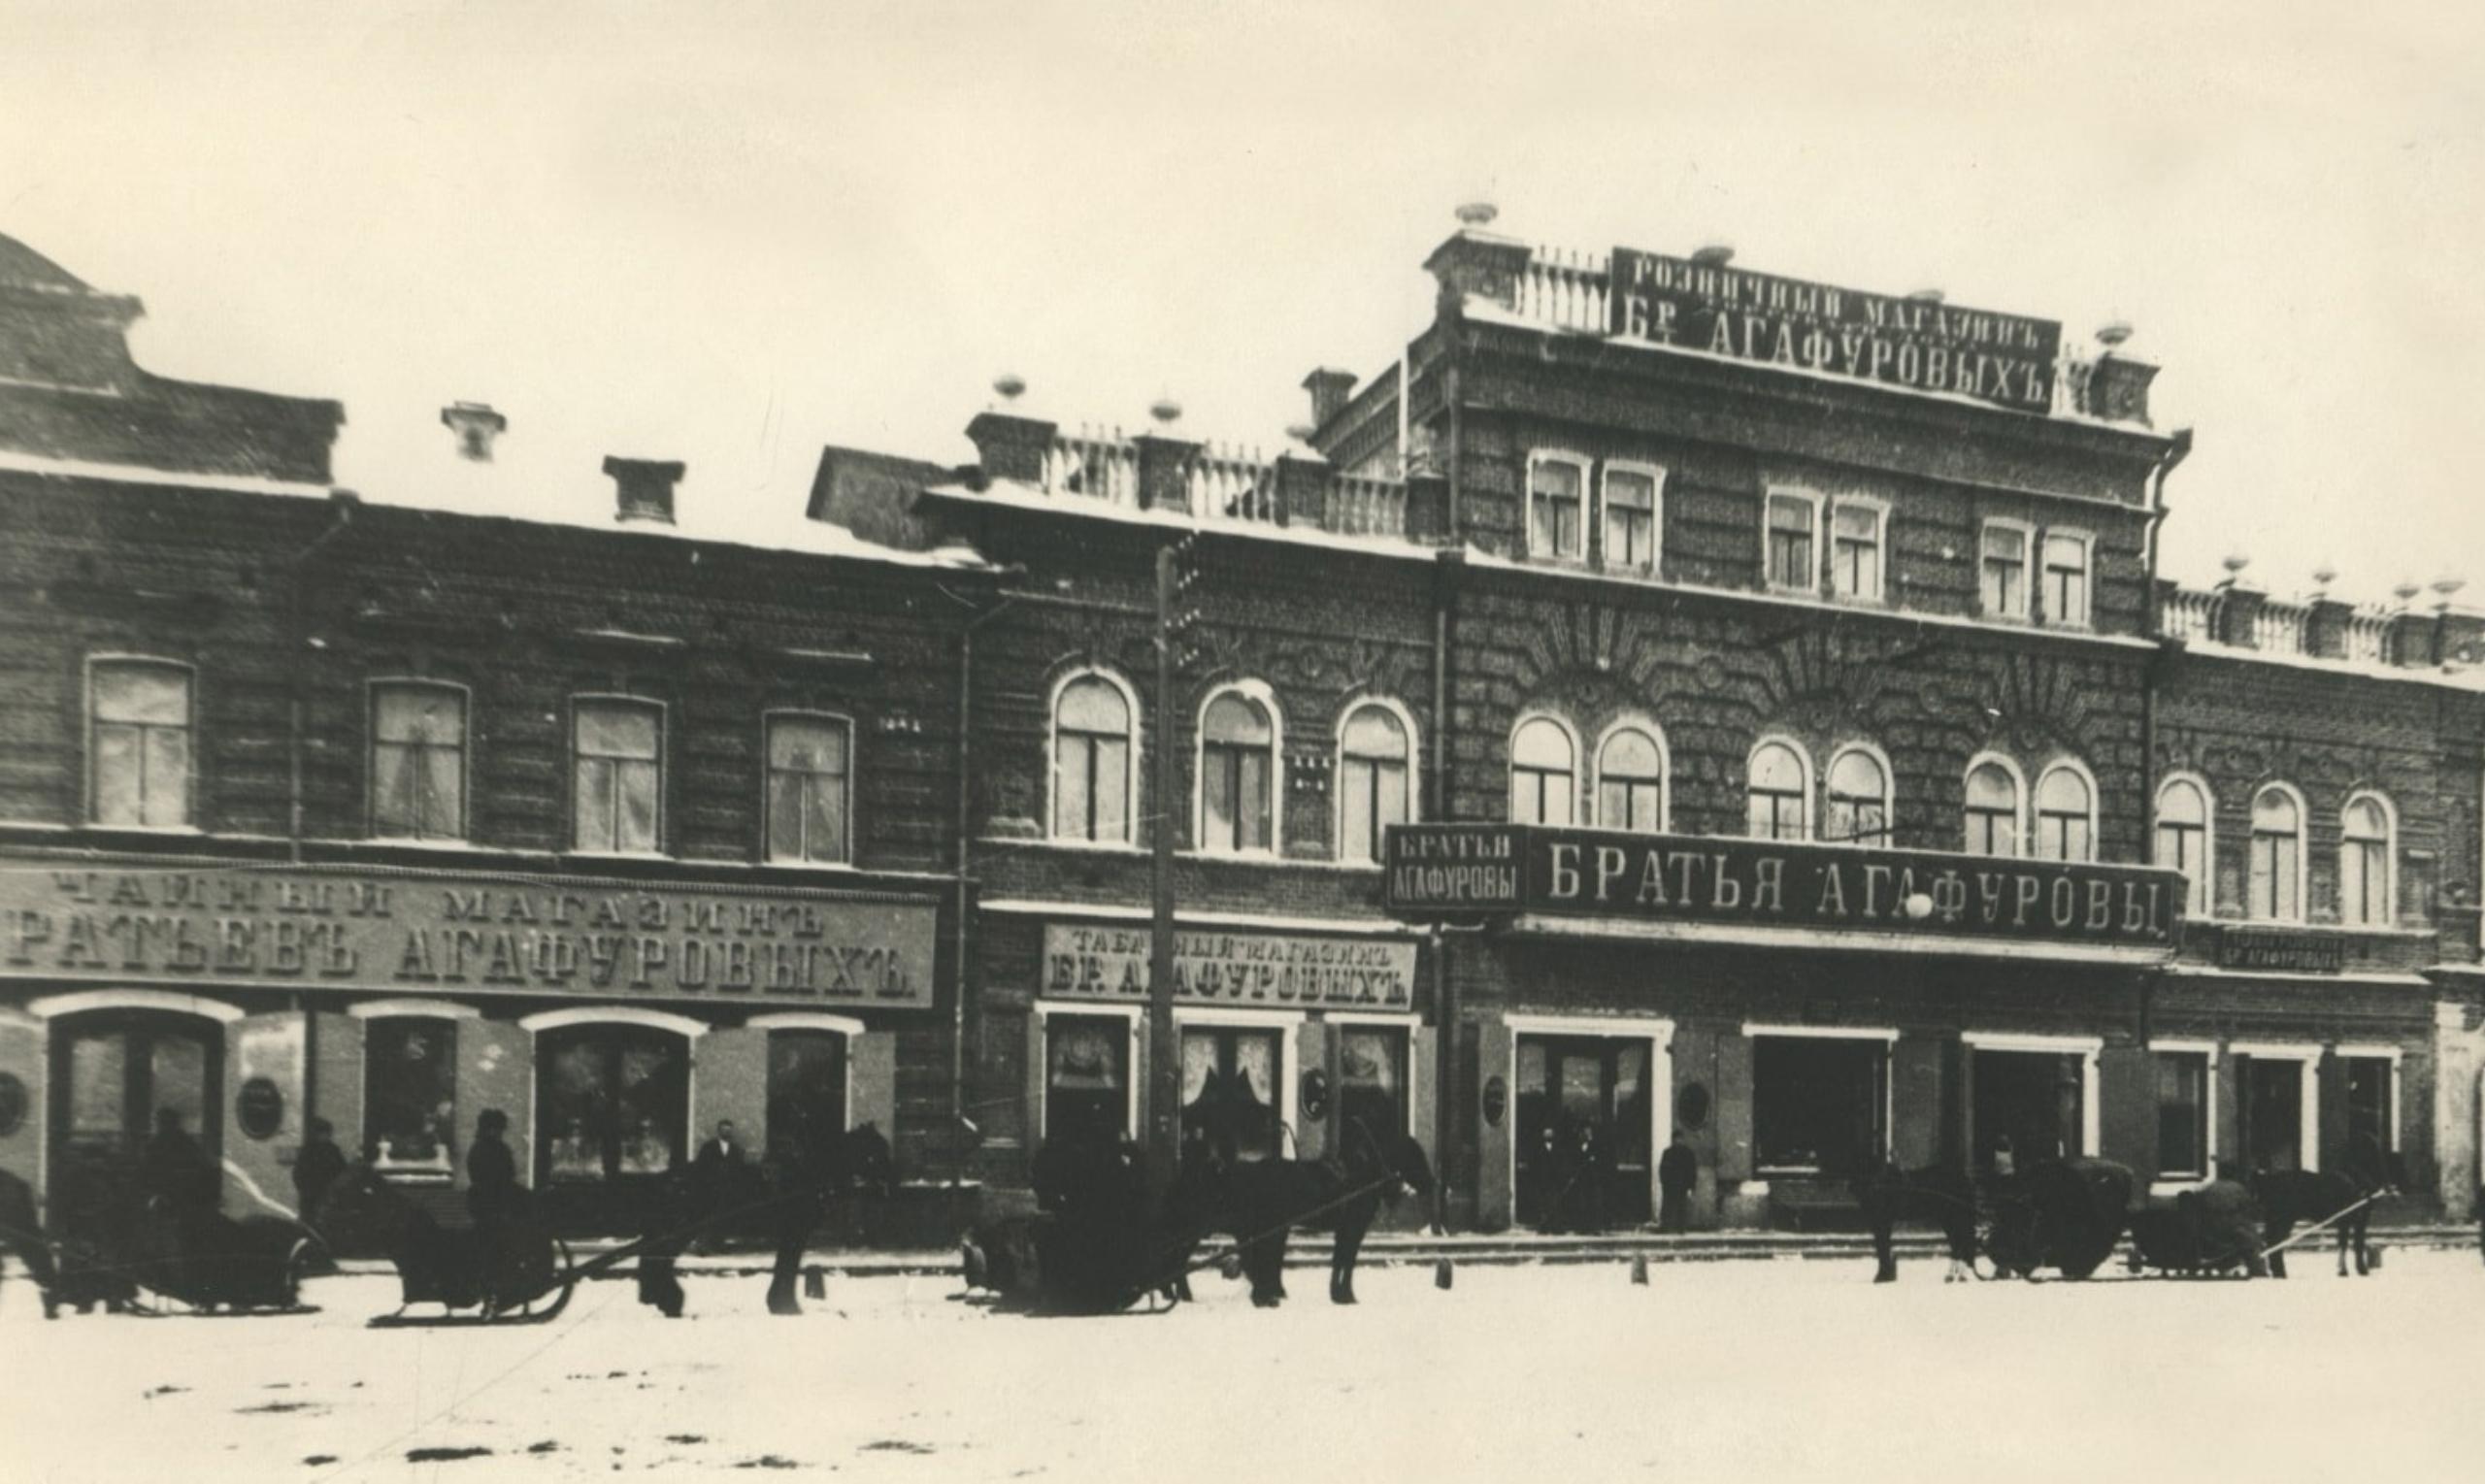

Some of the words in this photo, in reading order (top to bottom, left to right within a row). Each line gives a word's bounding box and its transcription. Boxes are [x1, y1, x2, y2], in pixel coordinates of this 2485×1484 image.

[1394, 864, 1517, 902] АГАФУРОВЫ
[1548, 842, 1786, 911] БРАТЬЯ
[444, 889, 823, 938] МАГАЗИНЪ
[1072, 928, 1235, 959] ТАБАНЫЙ
[1118, 956, 1408, 1005] ААФУРОВЫХЪ
